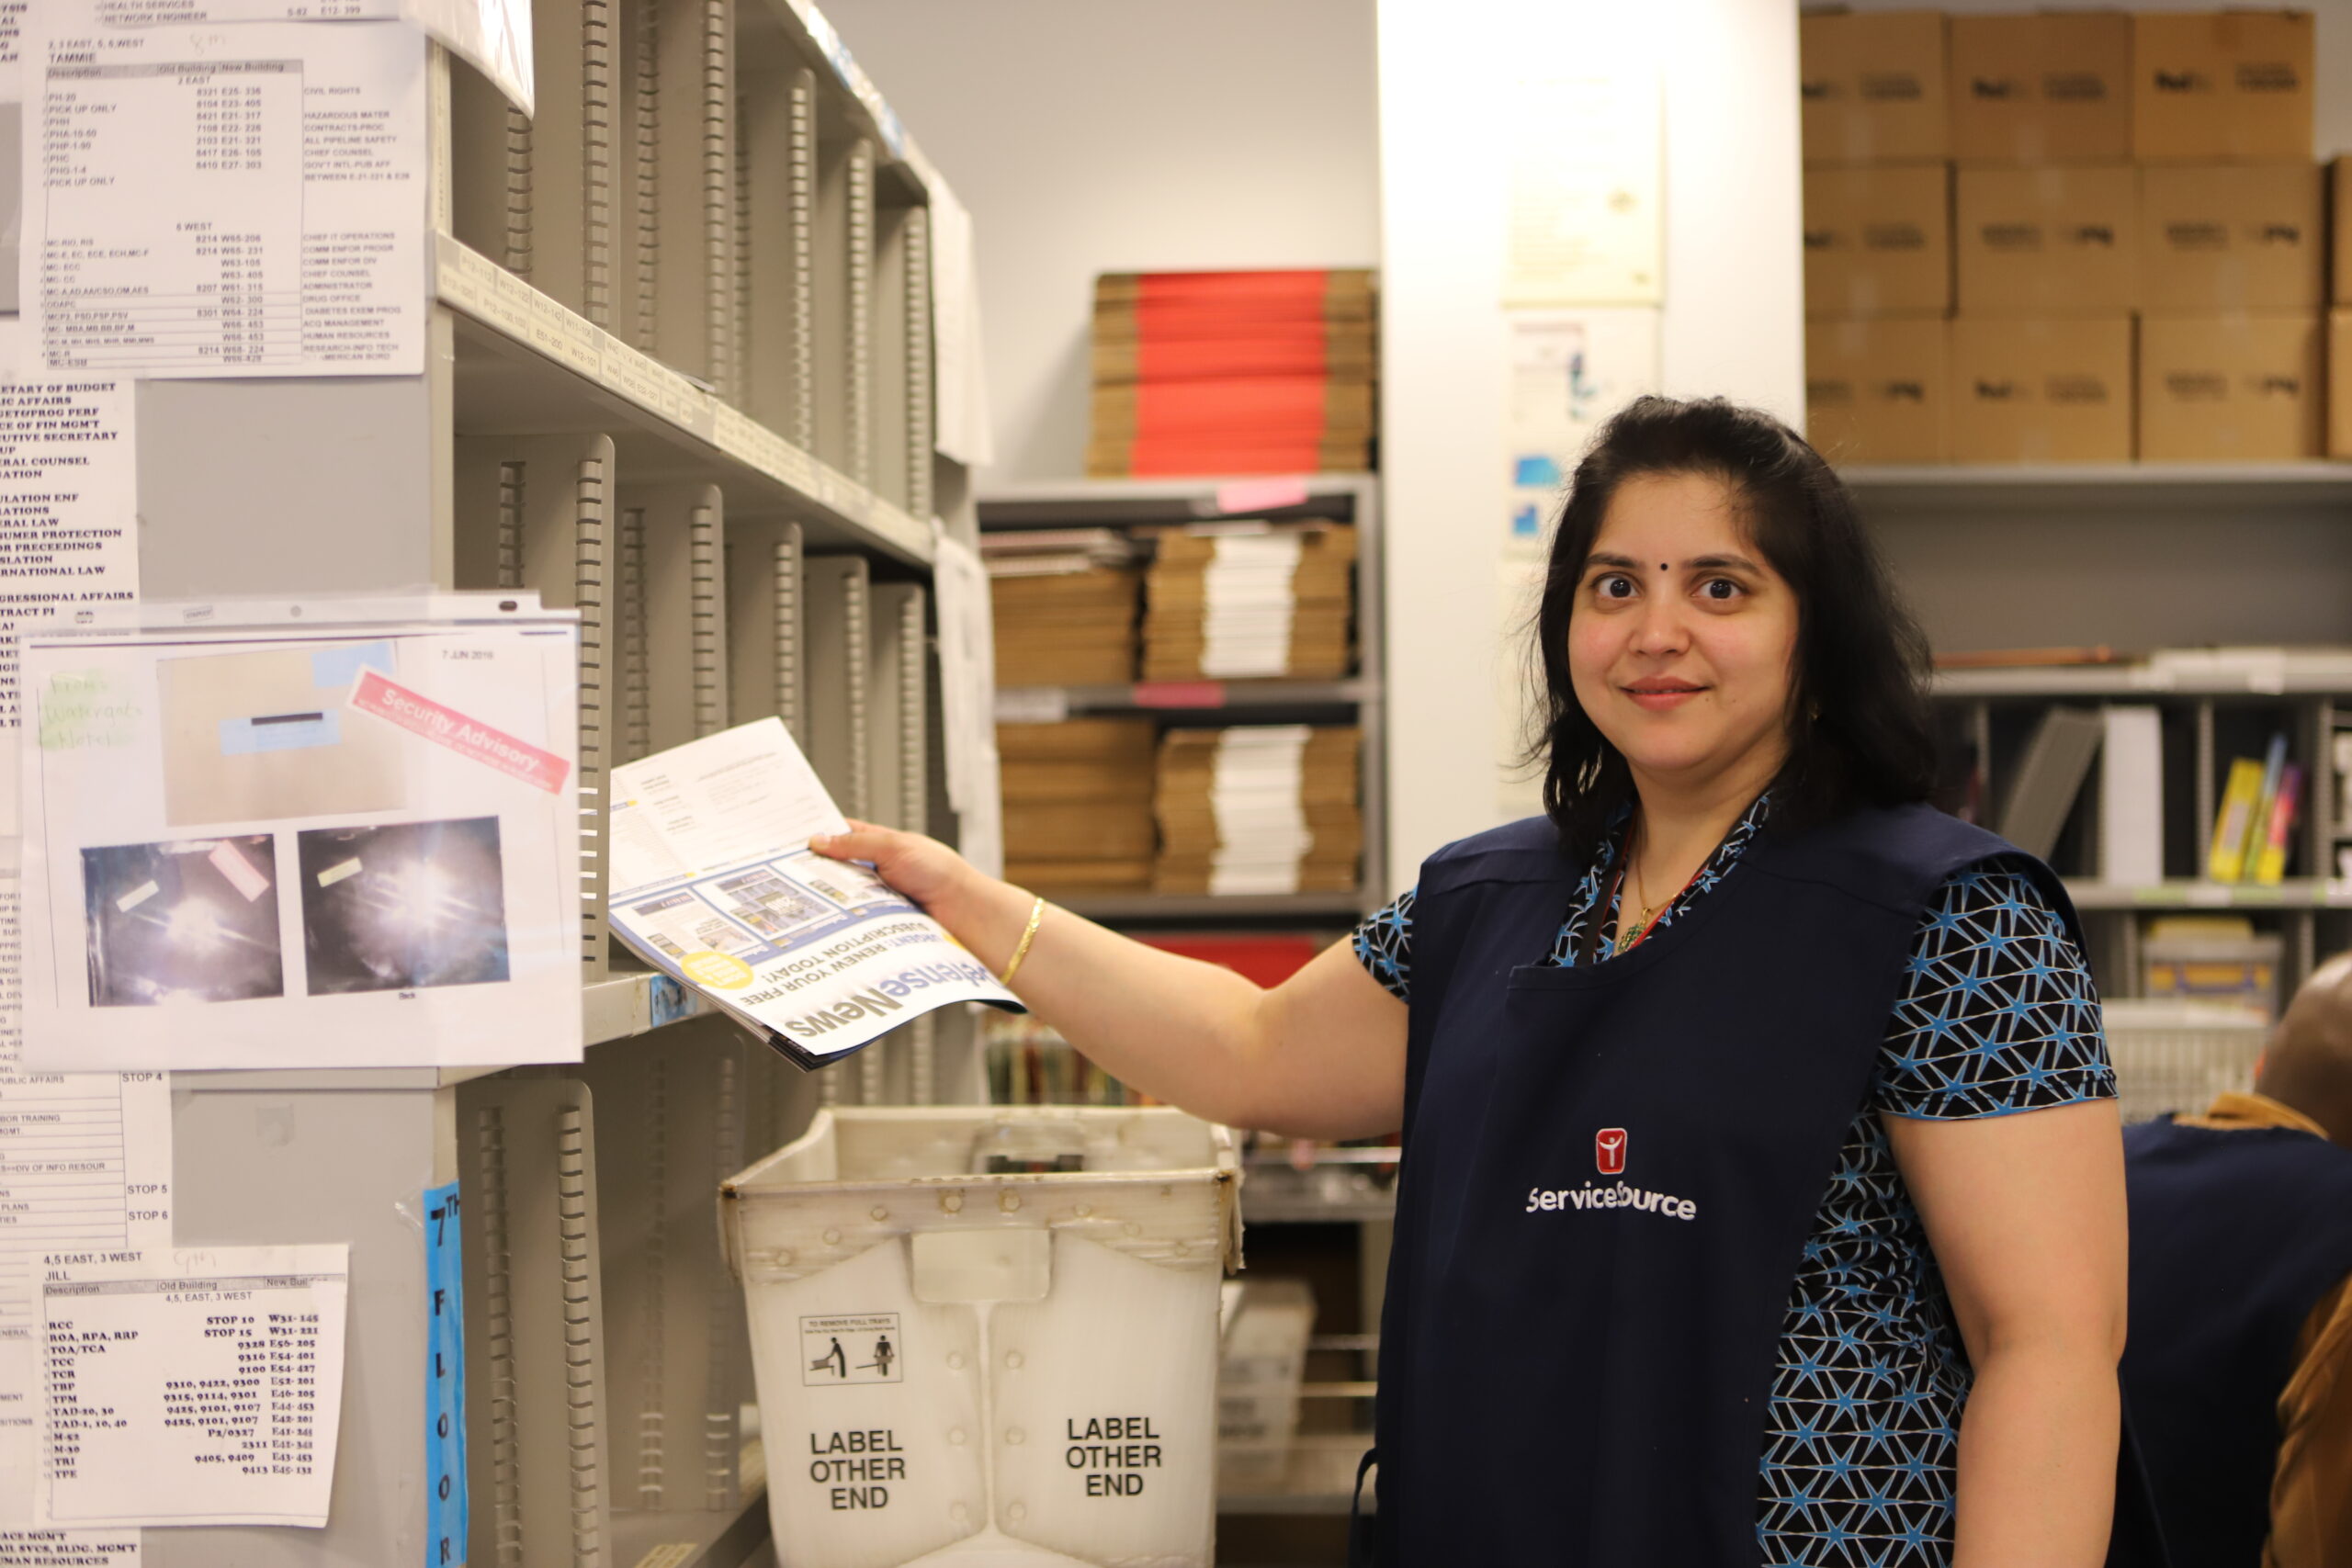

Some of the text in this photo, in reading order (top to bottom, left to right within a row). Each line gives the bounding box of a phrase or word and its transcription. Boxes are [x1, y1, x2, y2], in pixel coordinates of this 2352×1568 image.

[156, 11, 208, 22] ENGINEER
[50, 52, 96, 64] TAMMIE
[48, 68, 101, 79] Description
[158, 62, 285, 75] Old Building New Building
[186, 75, 211, 85] EAST
[303, 86, 360, 96] CIVIL RIGHTS
[184, 222, 212, 231] WEST
[340, 231, 395, 241] OPERATIONS
[330, 270, 371, 278] COUNSEL
[303, 281, 373, 290] ADMINISTRATOR
[303, 294, 360, 303] DRUG OFFICE
[305, 307, 347, 316] DIABETES
[323, 319, 384, 328] MANAGEMENT
[303, 332, 390, 340] HUMAN RESOURCES
[47, 382, 116, 394] OF BUDGET
[17, 397, 72, 407] AFFAIRS
[68, 408, 99, 417] PERF
[17, 421, 33, 431] OF
[36, 421, 57, 430] FIN
[43, 432, 118, 442] SECRETARY
[31, 457, 90, 467] COUNSEL
[54, 493, 79, 502] ENF
[31, 518, 59, 527] LAW
[41, 529, 123, 539] PROTECTION
[15, 542, 103, 552] PRECEEDINGS
[77, 566, 107, 576] LAW
[79, 592, 134, 602] AFFAIRS
[381, 687, 456, 737] Security
[458, 724, 540, 773] Advisory
[831, 943, 888, 972] RENEW
[761, 955, 825, 984] TODAY!
[781, 969, 831, 993] YOUR
[739, 987, 786, 1007] FREE
[29, 1075, 64, 1084] AFFAIRS
[121, 1073, 164, 1082] STOP 4
[21, 1113, 61, 1122] TRAINING
[31, 1162, 106, 1172] OF INFO RESOUR
[127, 1184, 158, 1194] STOP
[1, 1203, 29, 1212] PLANS
[128, 1211, 158, 1222] STOP
[44, 1255, 61, 1266] 4,5
[64, 1253, 97, 1265] EAST,
[109, 1251, 143, 1262] WEST
[45, 1271, 71, 1281] JILL
[160, 1280, 217, 1292] Old Building
[266, 1278, 287, 1286] New
[46, 1284, 100, 1297] Description
[185, 1292, 213, 1303] EAST,
[223, 1292, 252, 1302] WEST
[206, 1315, 255, 1325] STOP 10
[48, 1321, 74, 1330] RCC
[114, 1332, 138, 1341] RRP
[204, 1328, 252, 1338] STOP 15
[50, 1345, 107, 1356] TOA/TCA
[237, 1341, 266, 1350] 9328
[51, 1358, 74, 1367] TCC
[237, 1352, 316, 1363] 9316 401
[238, 1366, 266, 1375] 9100
[232, 1379, 261, 1389] 9300
[51, 1395, 77, 1404] TPM
[230, 1391, 257, 1401] 9301
[101, 1407, 114, 1416] 30
[233, 1404, 261, 1414] 9107
[232, 1416, 259, 1426] 9107
[434, 1288, 452, 1567] FLOOR
[1068, 1416, 1160, 1441] LABEL
[241, 1440, 267, 1450] 2311
[810, 1430, 903, 1455] LABEL
[228, 1453, 255, 1462] 9409
[1066, 1445, 1162, 1469] OTHER
[55, 1470, 77, 1479] TPE
[809, 1457, 907, 1483] OTHER
[1086, 1473, 1144, 1497] END
[831, 1486, 888, 1511] END
[35, 1556, 109, 1566] RESOURCES
